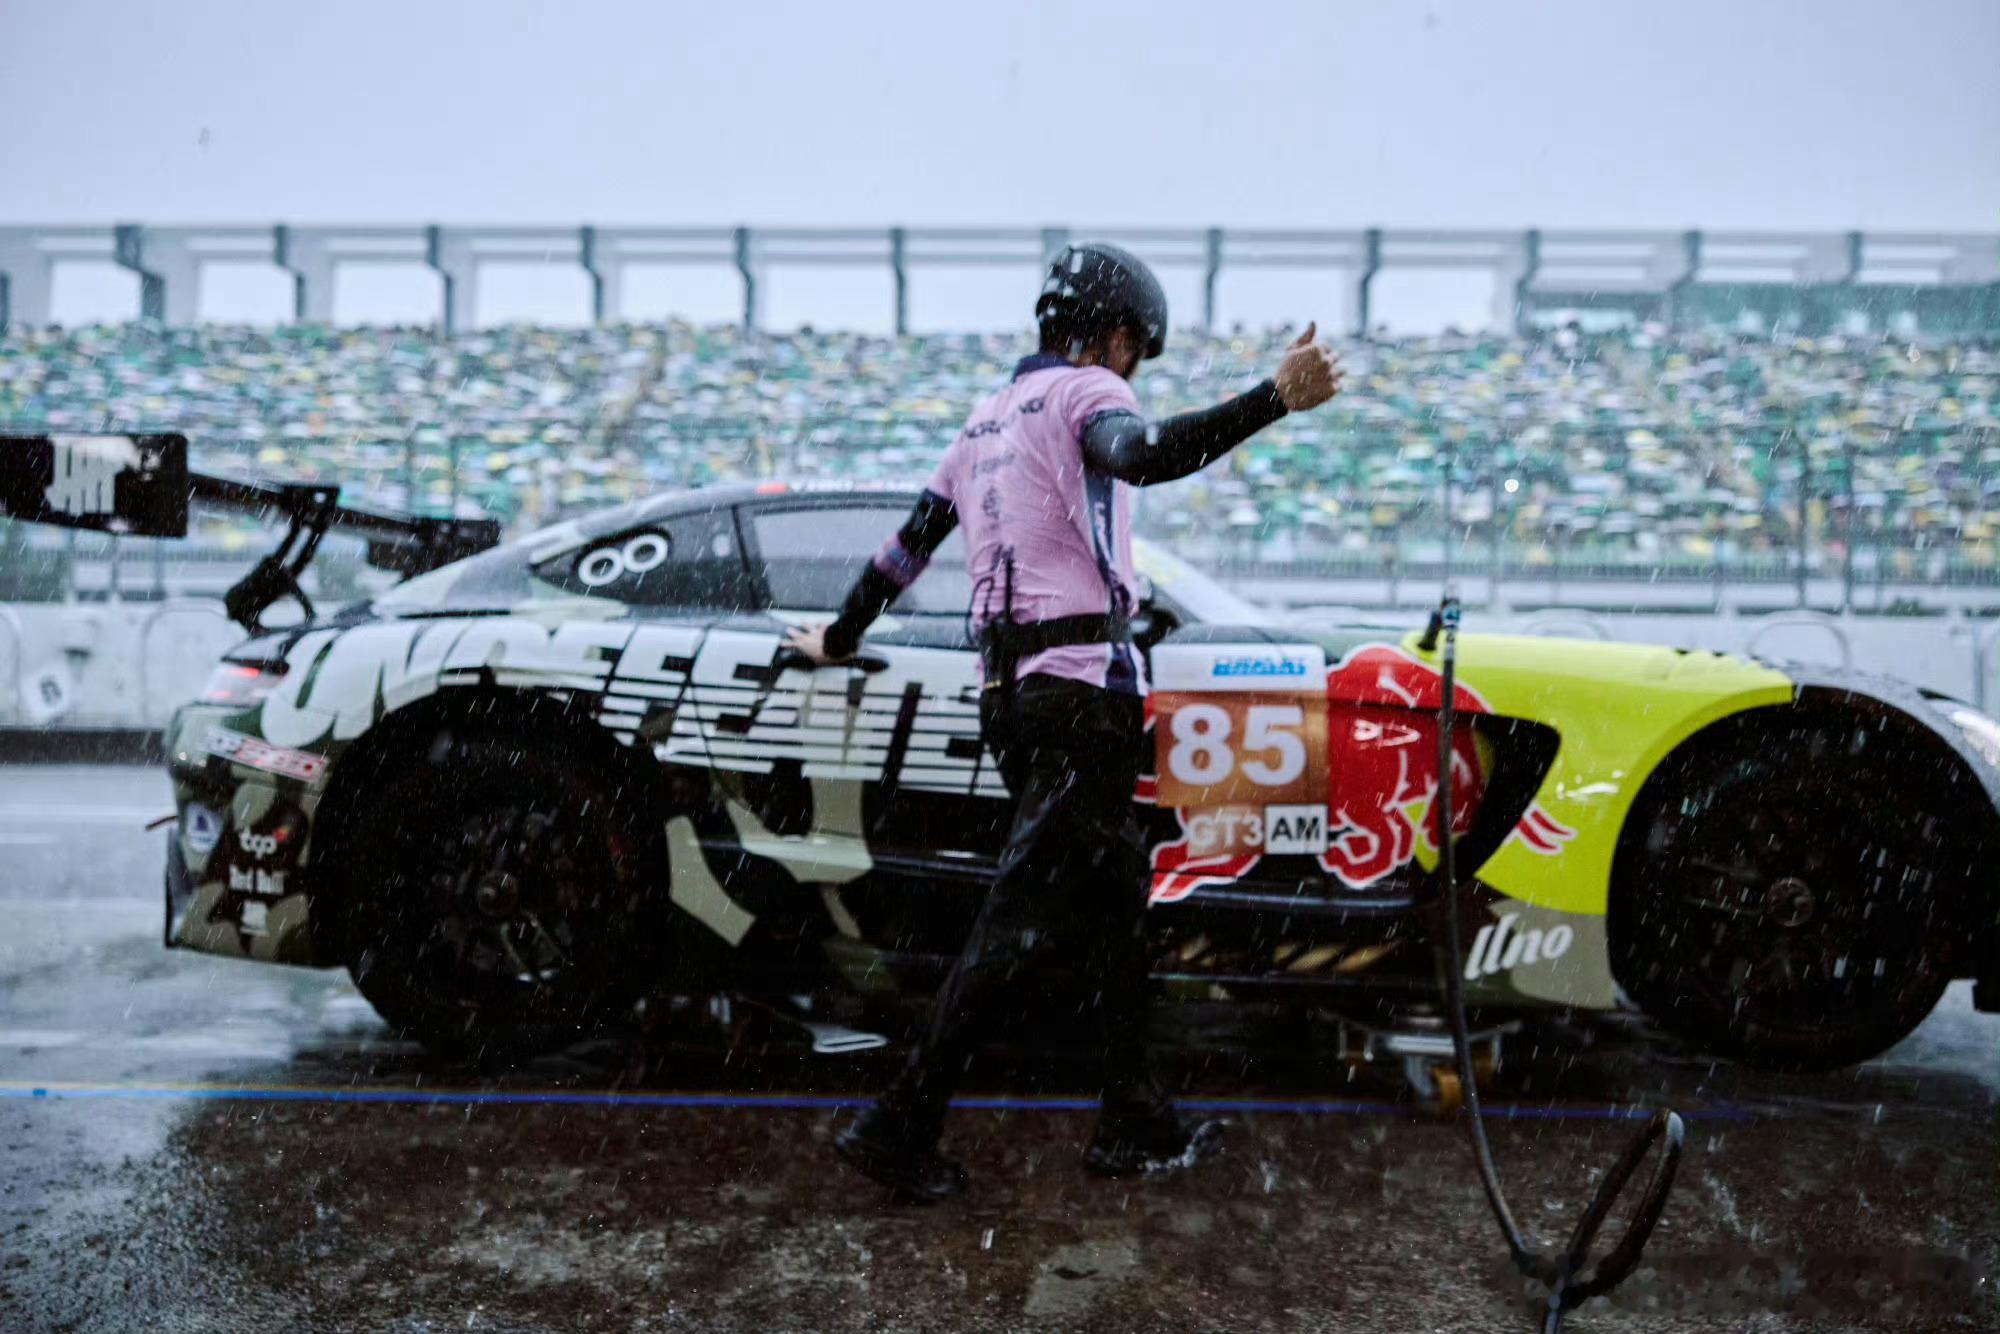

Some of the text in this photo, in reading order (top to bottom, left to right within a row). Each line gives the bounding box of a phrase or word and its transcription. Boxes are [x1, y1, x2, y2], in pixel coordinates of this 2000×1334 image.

[1168, 703, 1307, 786] 85
[1186, 814, 1321, 847] GT3 AM
